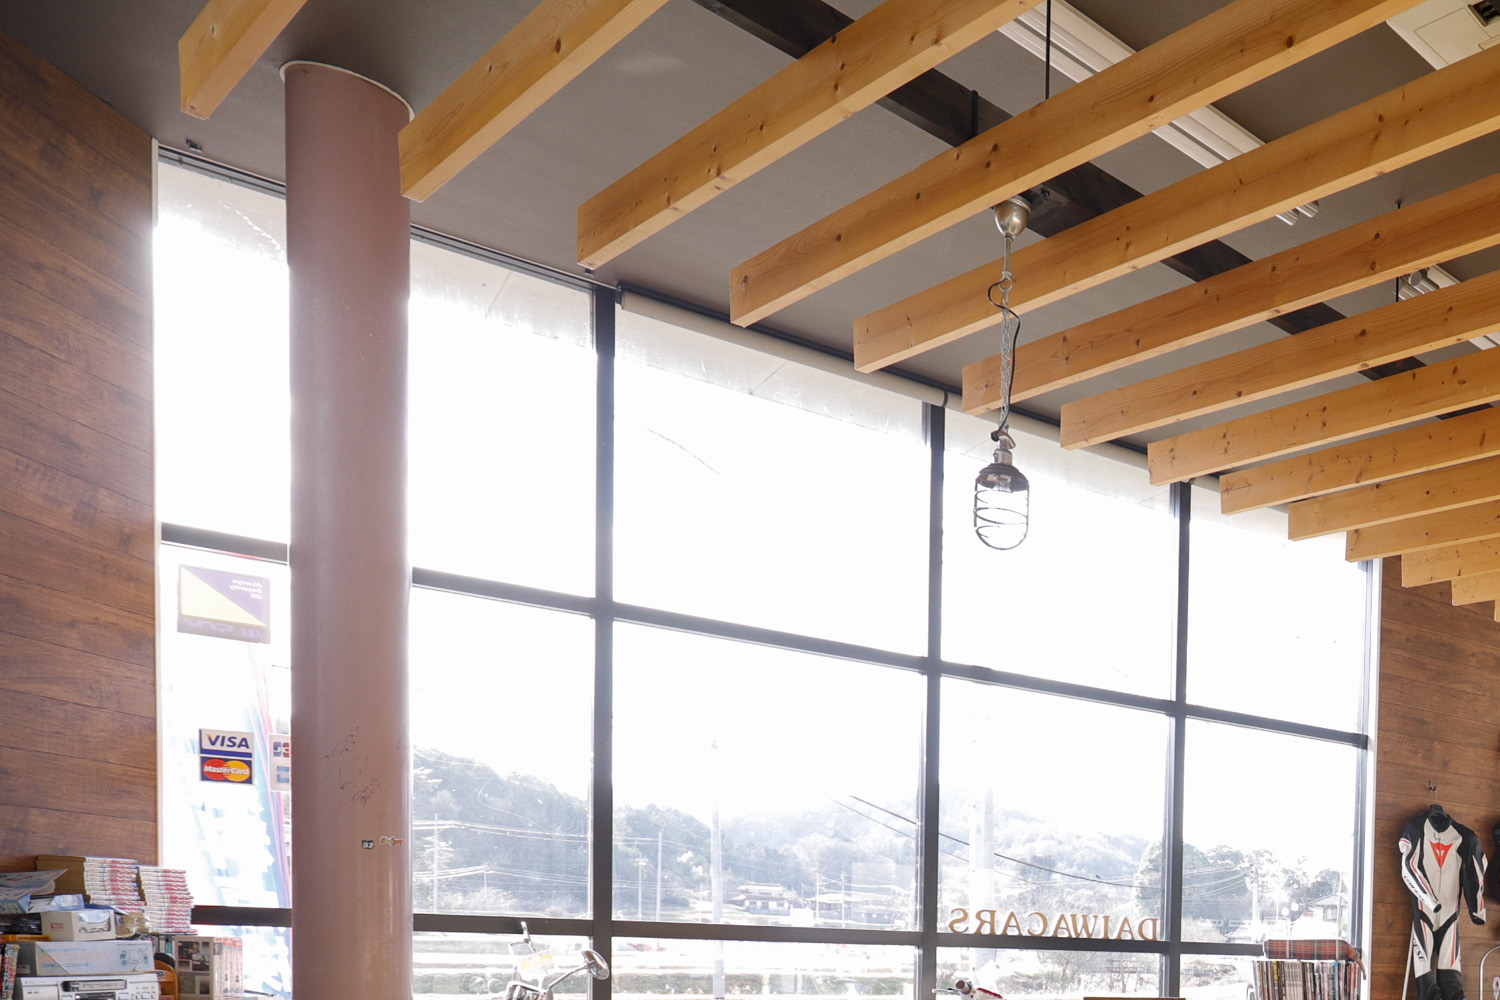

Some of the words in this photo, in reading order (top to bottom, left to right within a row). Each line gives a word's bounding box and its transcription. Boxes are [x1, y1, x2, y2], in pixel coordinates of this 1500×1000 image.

[205, 734, 250, 749] VISA
[203, 765, 249, 775] MasterCard
[362, 841, 374, 849] 52
